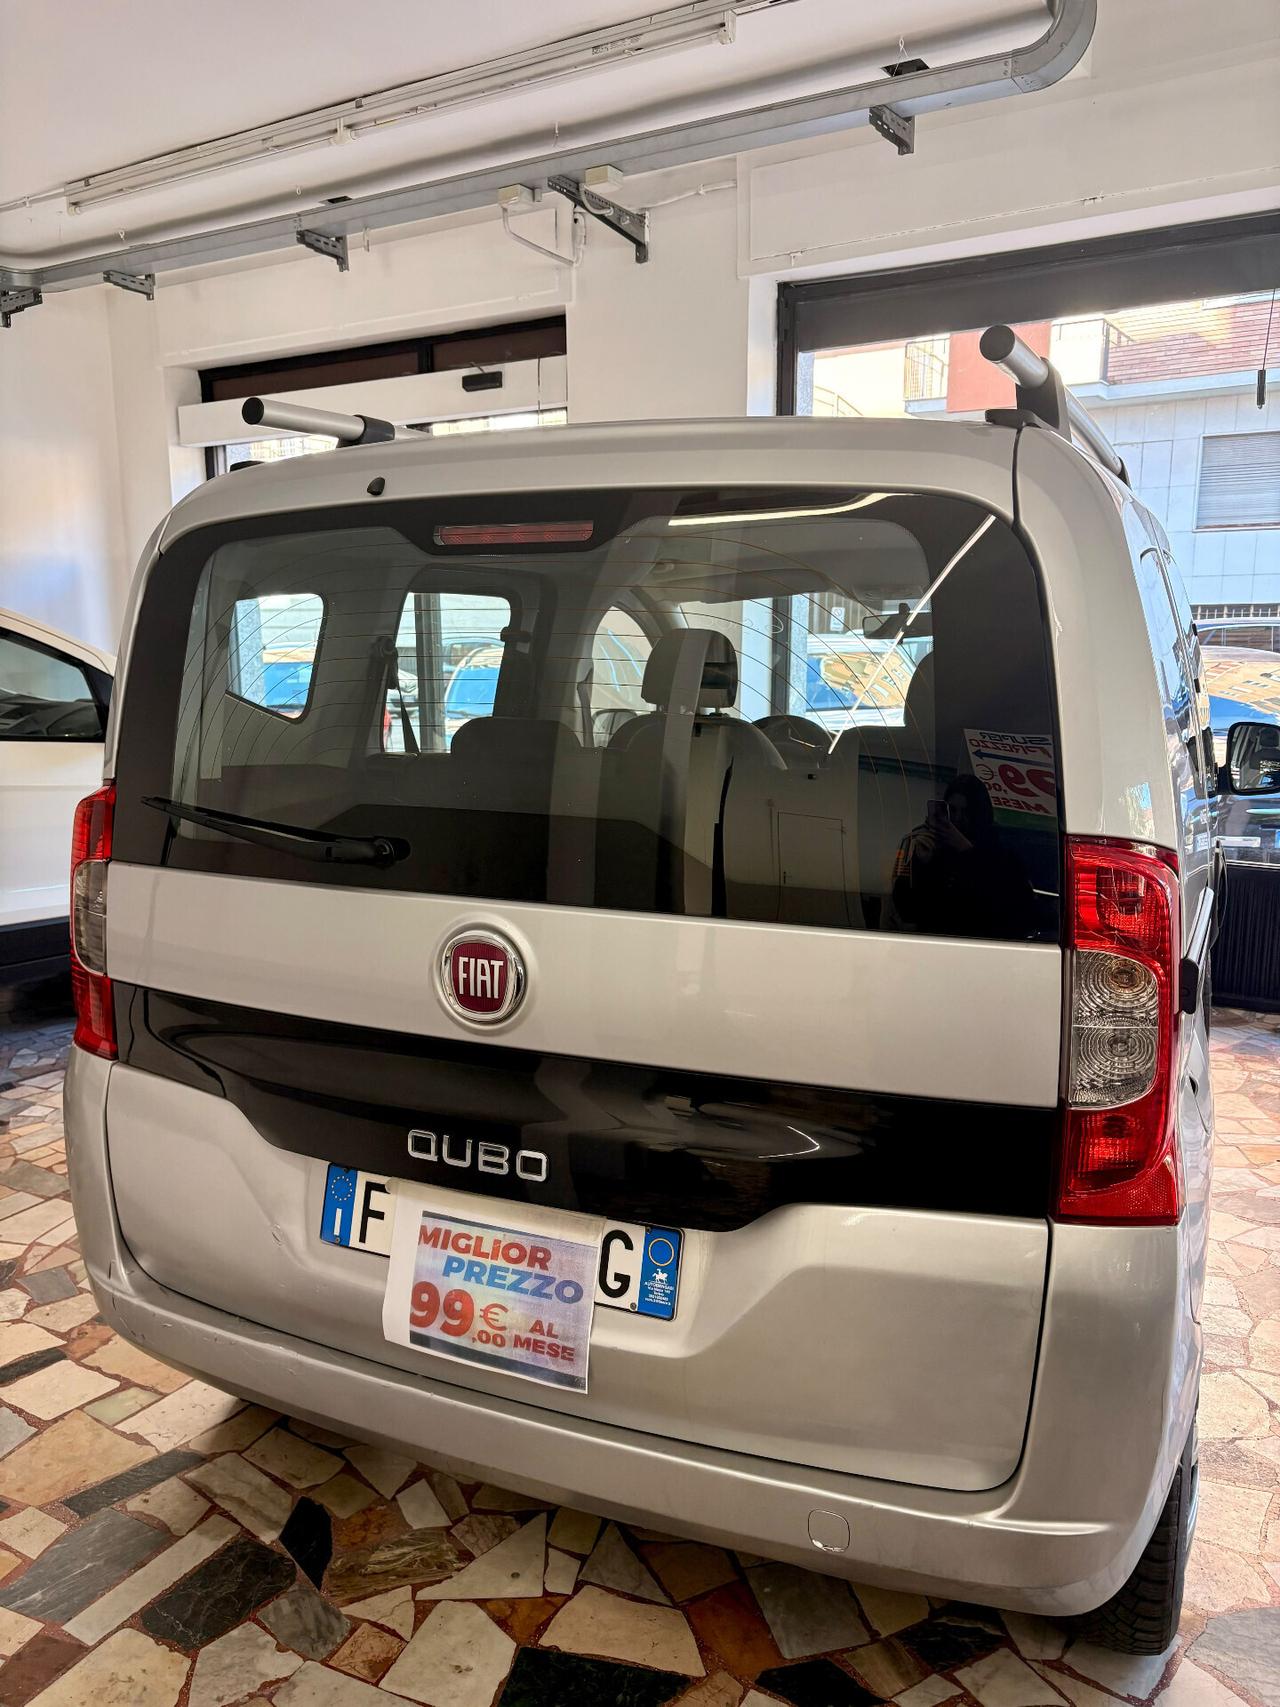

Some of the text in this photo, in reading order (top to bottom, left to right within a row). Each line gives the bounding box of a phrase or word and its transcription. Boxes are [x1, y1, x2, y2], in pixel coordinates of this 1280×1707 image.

[458, 956, 504, 999] FIAT
[407, 1129, 548, 1182] QUBO
[418, 1225, 552, 1271] MIGLIOR
[442, 1255, 584, 1304] PREZZO
[513, 1334, 577, 1362] MESE
[529, 1319, 559, 1339] AL
